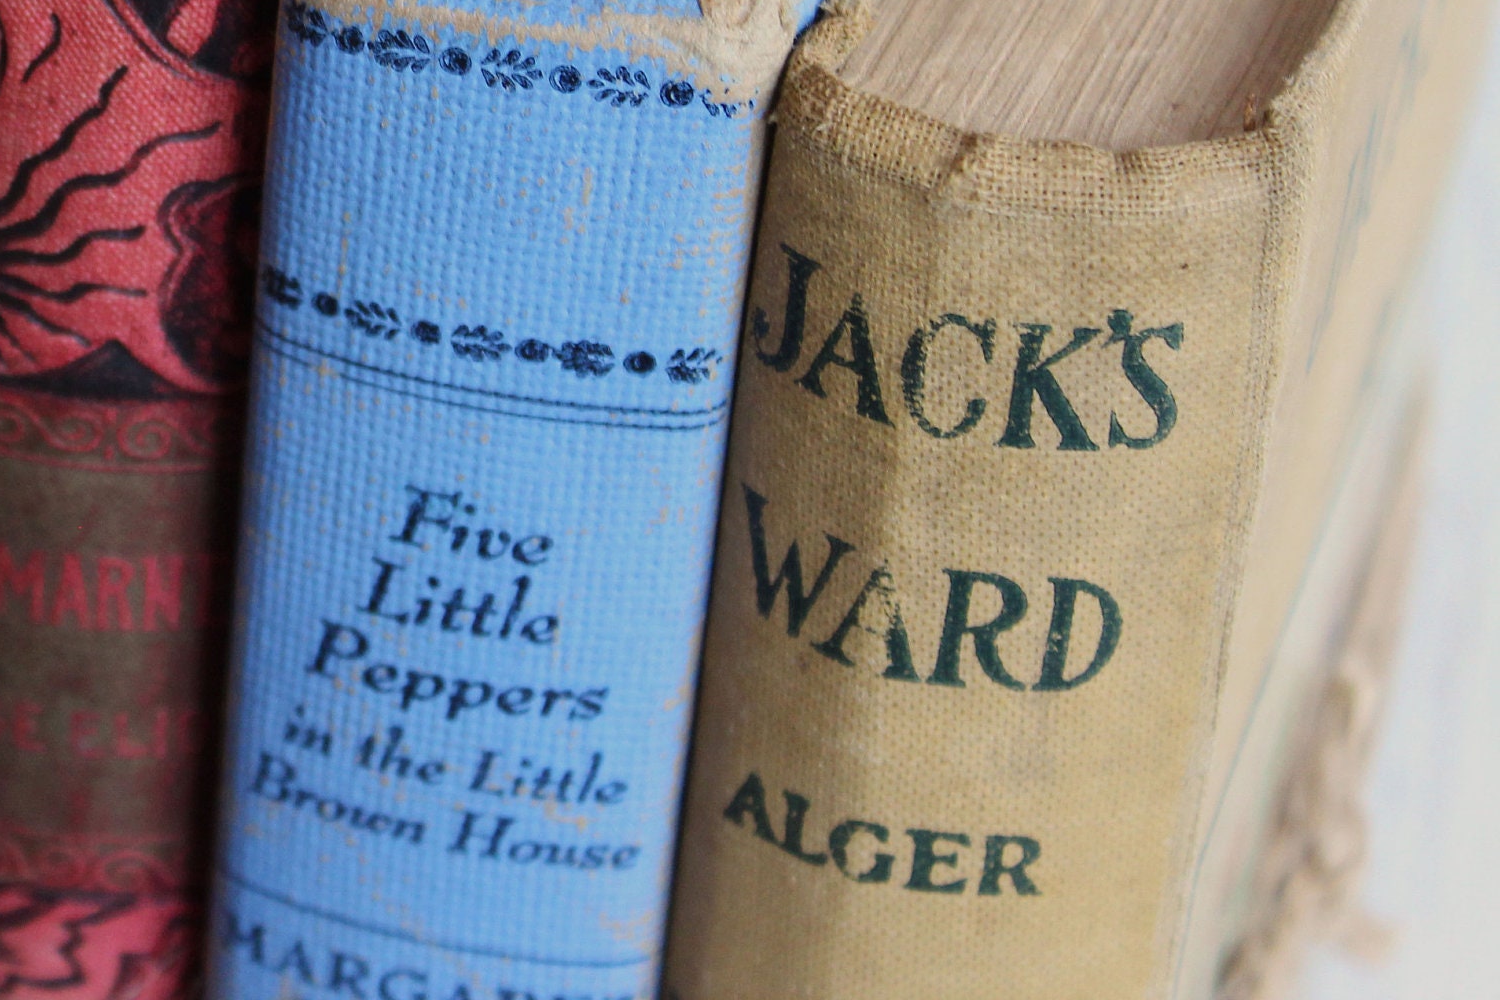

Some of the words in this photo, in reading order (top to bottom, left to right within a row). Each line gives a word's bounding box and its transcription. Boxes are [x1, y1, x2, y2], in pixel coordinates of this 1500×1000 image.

[753, 242, 1185, 452] JACK'S
[389, 484, 555, 567] Five
[357, 556, 560, 646] Little
[741, 482, 1124, 692] WARD
[305, 619, 610, 723] Peppers
[283, 704, 333, 756] in
[358, 724, 447, 786] the
[469, 750, 630, 806] Little
[249, 751, 427, 845] Brown
[447, 808, 643, 871] House
[723, 771, 1042, 896] ALGER
[222, 908, 645, 1000] MARG
